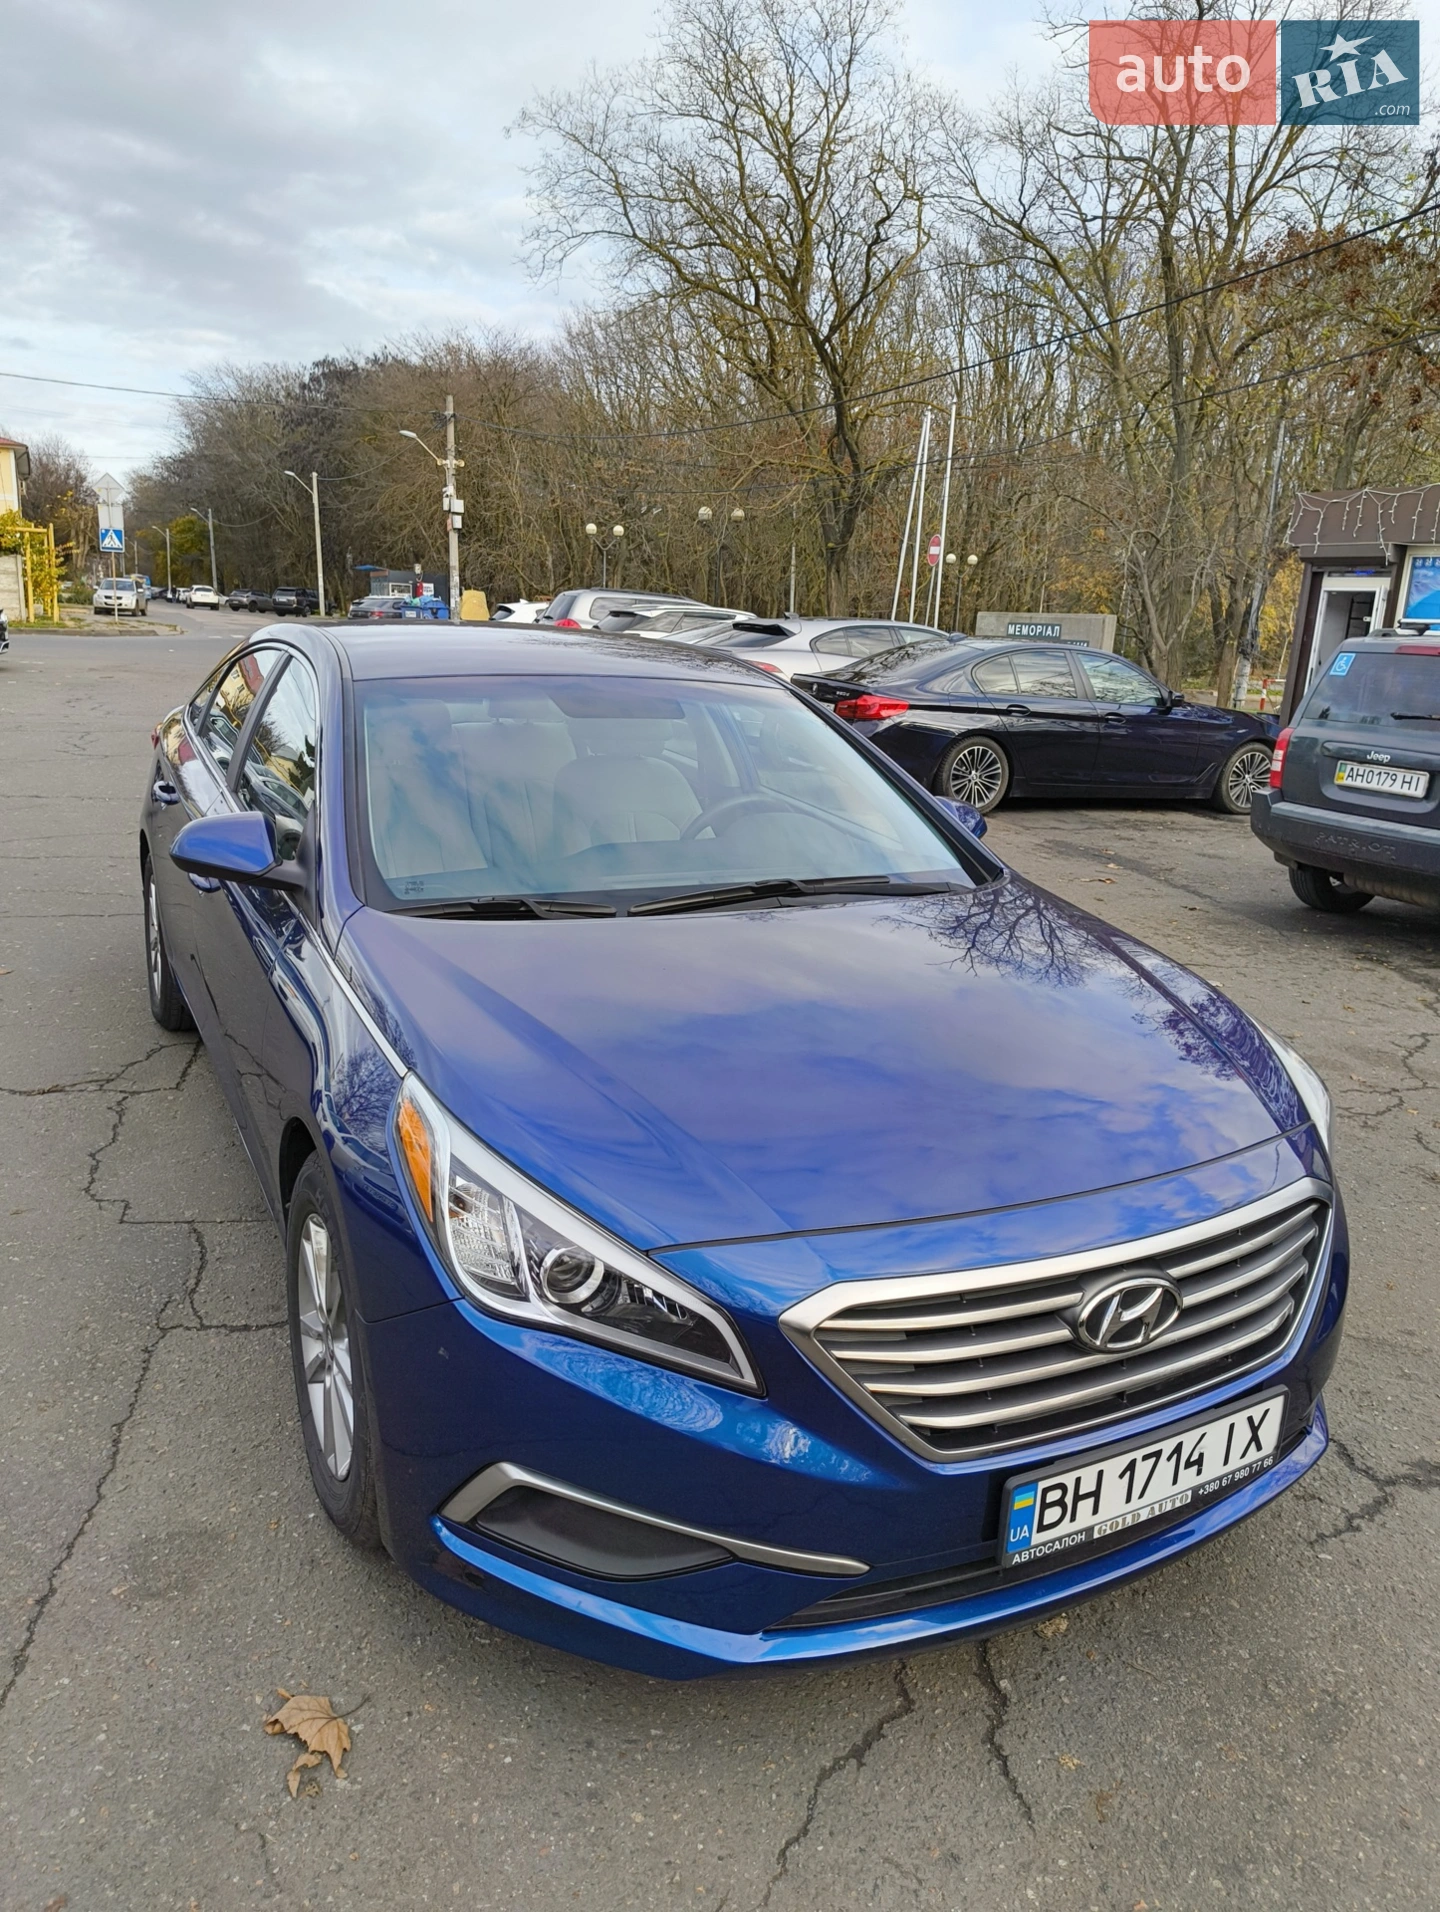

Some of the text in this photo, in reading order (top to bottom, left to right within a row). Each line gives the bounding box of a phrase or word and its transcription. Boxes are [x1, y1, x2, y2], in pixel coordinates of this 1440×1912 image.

[1008, 624, 1060, 637] МЕМОРІАЛ
[1366, 751, 1391, 763] Jeep
[1400, 774, 1420, 792] HI
[1036, 1408, 1270, 1534] BH 1714 IX
[1012, 1456, 1274, 1565] АВТОСАЛОН GOLD AUTO +380 67 980 77 66
[1010, 1524, 1030, 1542] UA
